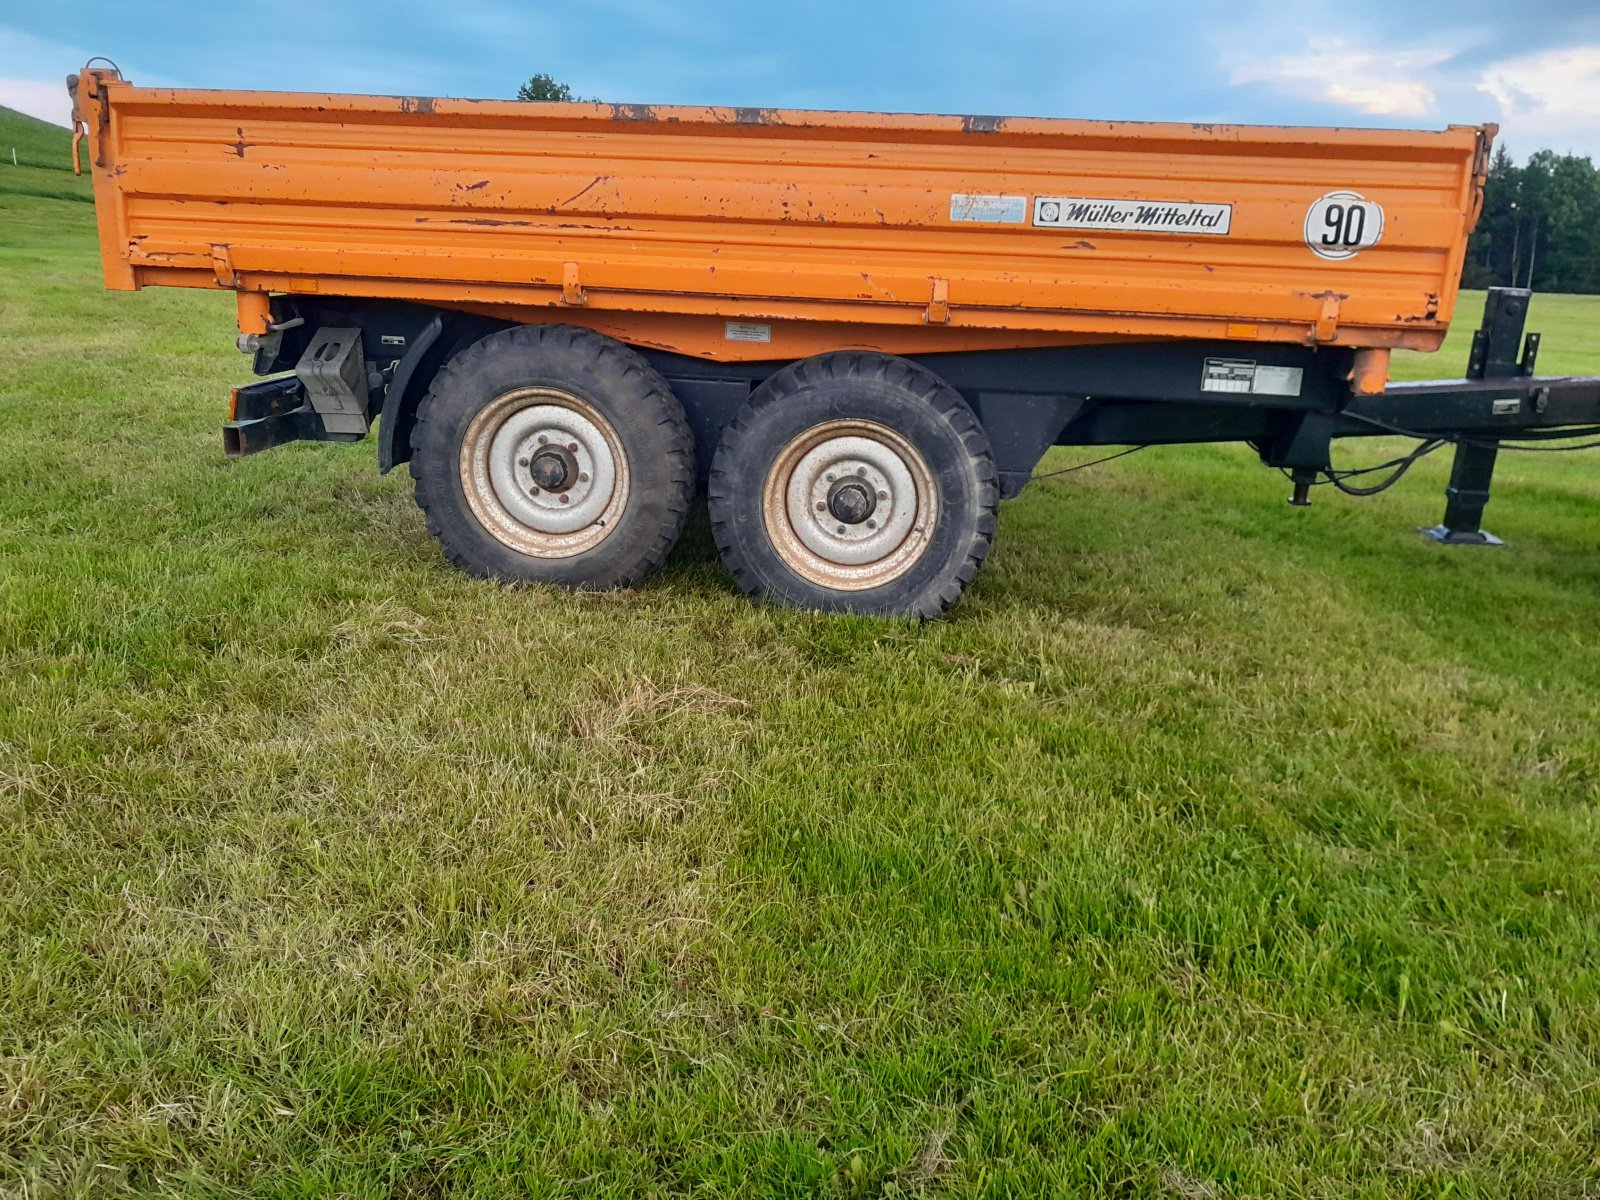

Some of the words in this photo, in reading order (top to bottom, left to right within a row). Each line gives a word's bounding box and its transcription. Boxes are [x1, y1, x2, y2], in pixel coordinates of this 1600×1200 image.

[1066, 202, 1133, 223] Müller
[1134, 205, 1225, 228] Mitteltal
[1322, 204, 1366, 246] 90
